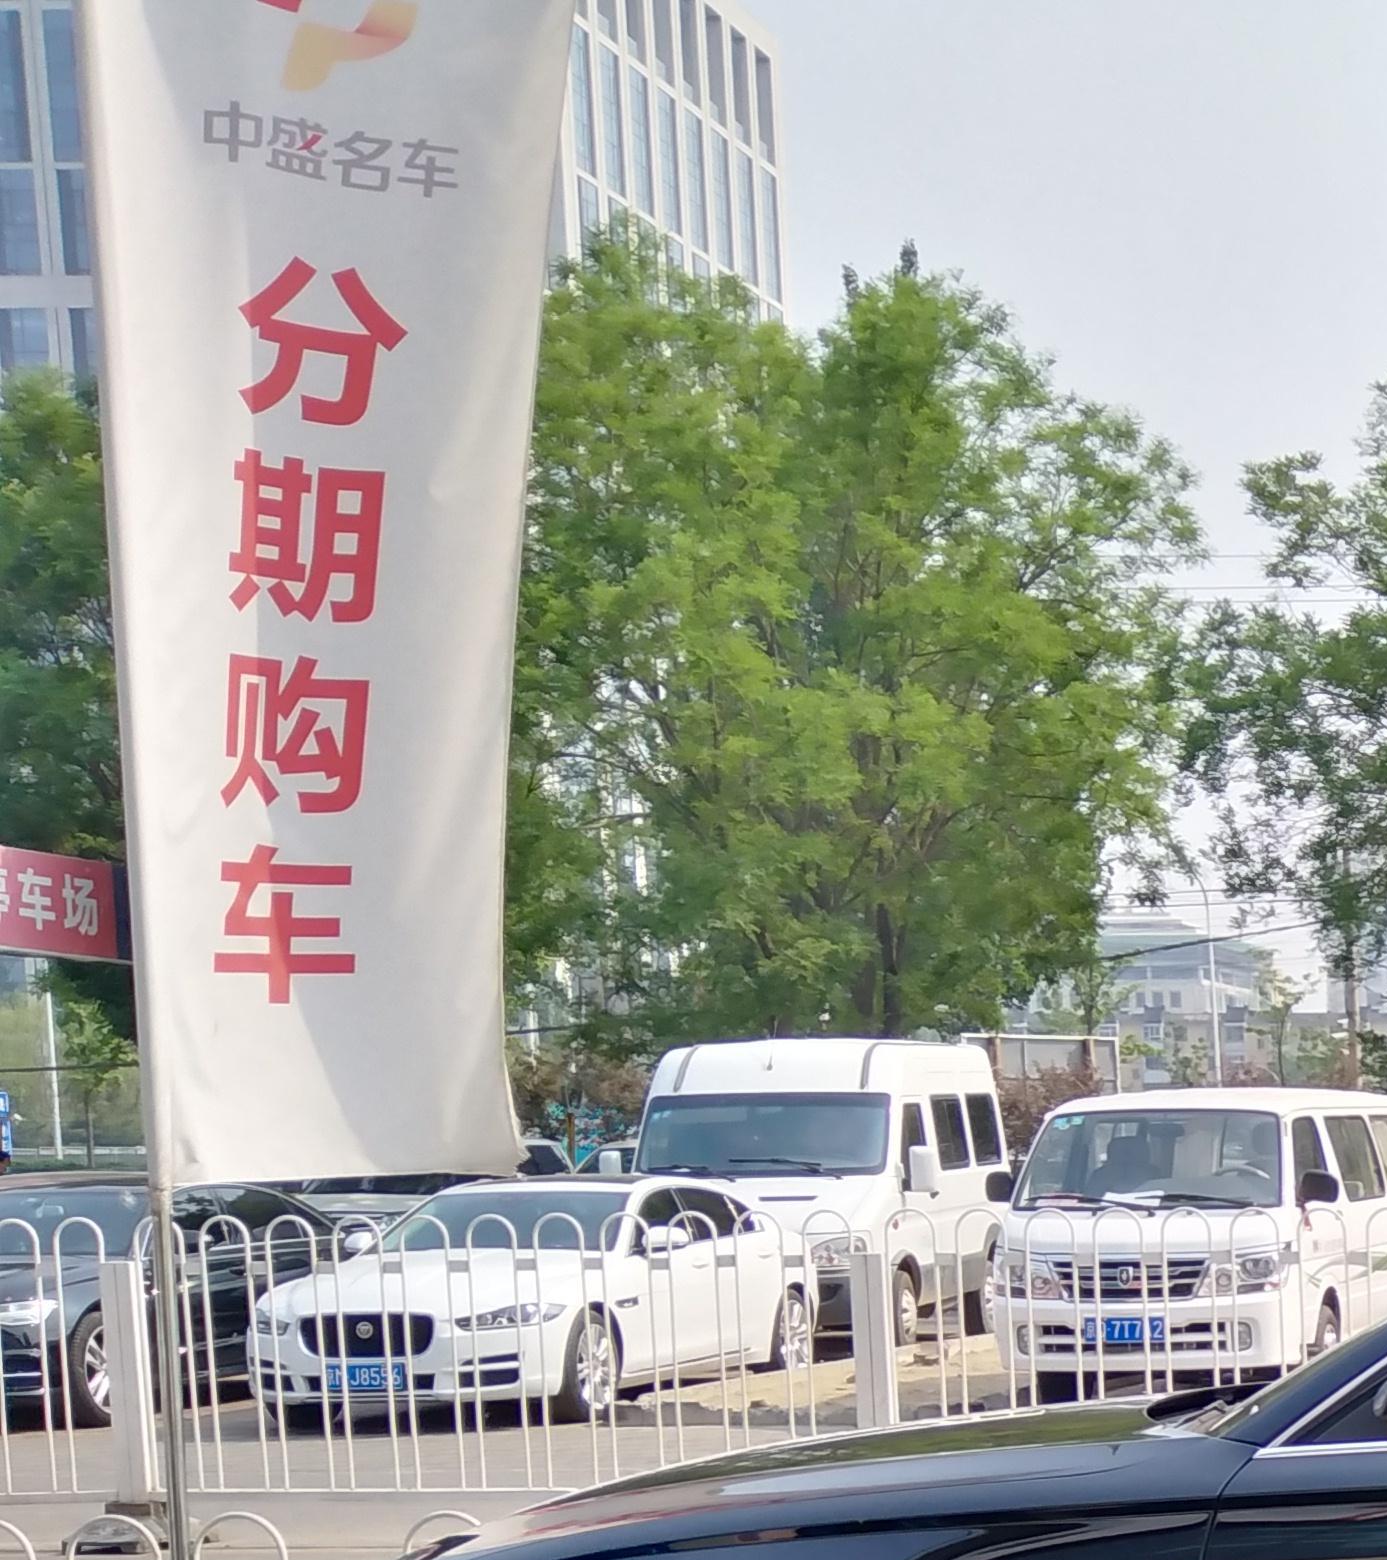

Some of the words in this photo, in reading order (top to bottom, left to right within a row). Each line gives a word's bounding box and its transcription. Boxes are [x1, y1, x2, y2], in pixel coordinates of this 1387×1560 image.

[203, 100, 459, 198] 中盛名车
[214, 256, 408, 1004] 分期购车
[1086, 1319, 1164, 1339] 京·7T72
